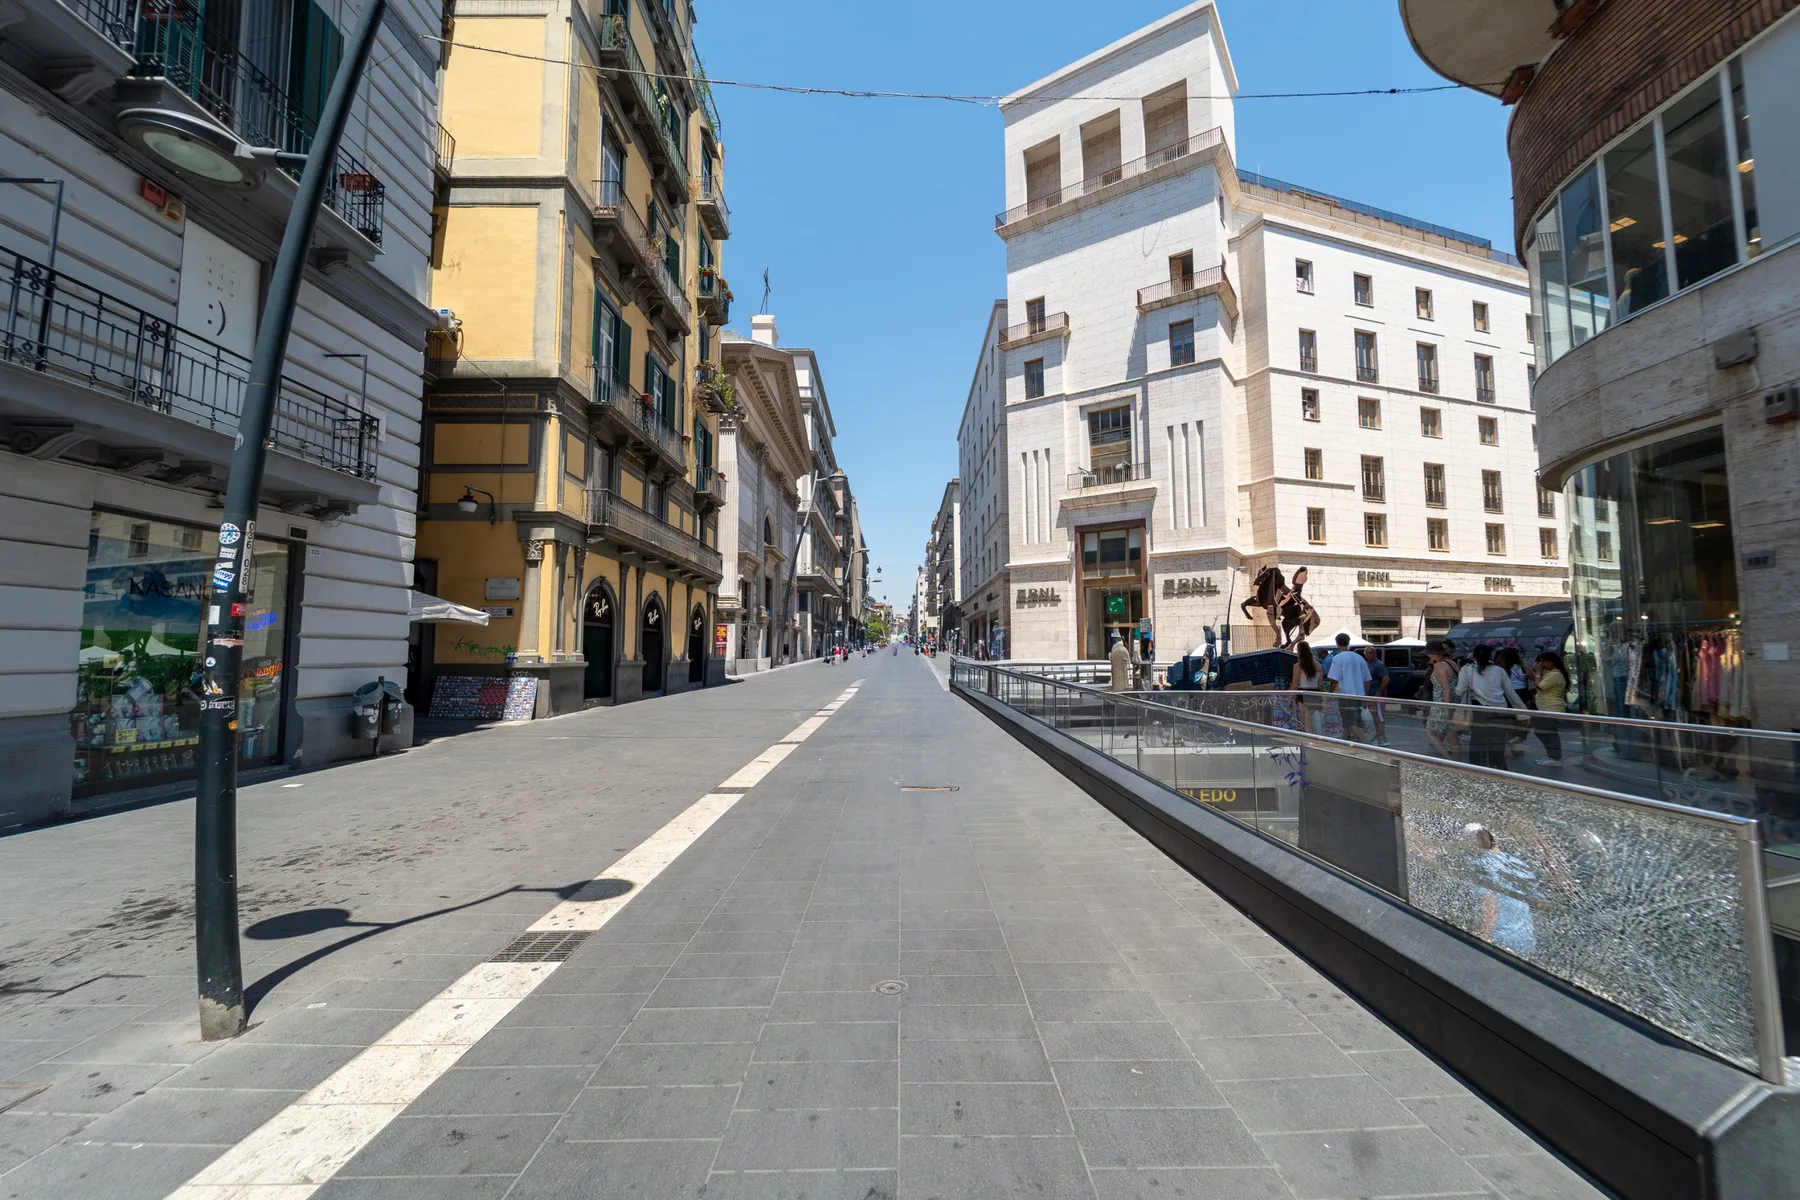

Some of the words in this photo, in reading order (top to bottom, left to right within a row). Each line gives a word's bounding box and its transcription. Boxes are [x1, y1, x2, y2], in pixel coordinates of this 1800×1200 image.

[246, 522, 255, 549] 036
[242, 558, 250, 586] 028
[1027, 587, 1060, 599] BNL
[1177, 576, 1218, 590] BNL
